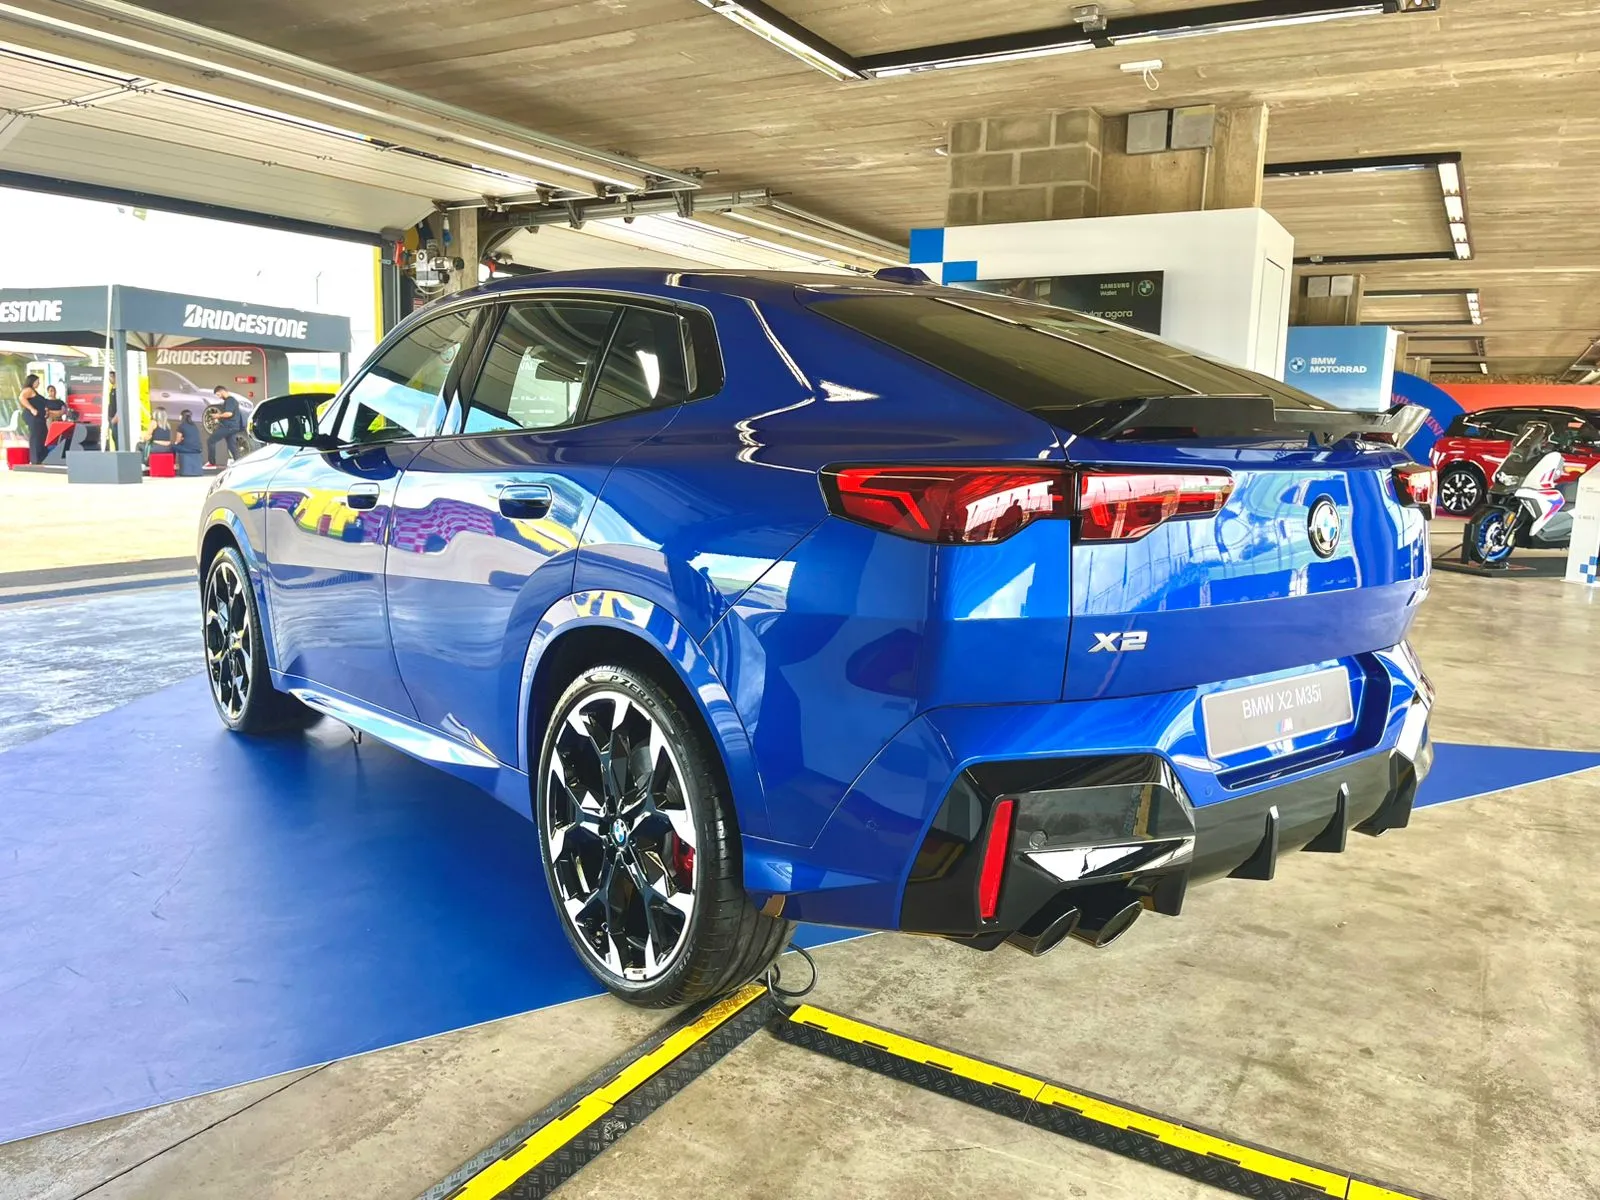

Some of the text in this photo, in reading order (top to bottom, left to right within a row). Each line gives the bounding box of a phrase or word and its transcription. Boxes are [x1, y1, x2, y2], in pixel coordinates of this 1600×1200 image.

[183, 304, 308, 339] BRIDGESTONE
[1105, 310, 1133, 320] agora
[156, 349, 252, 366] BRIDGESTONE
[1310, 365, 1367, 373] MOTORRAD
[1087, 631, 1148, 653] X2
[609, 674, 657, 708] P ZERO
[1242, 683, 1323, 719] BMW X2 M35i
